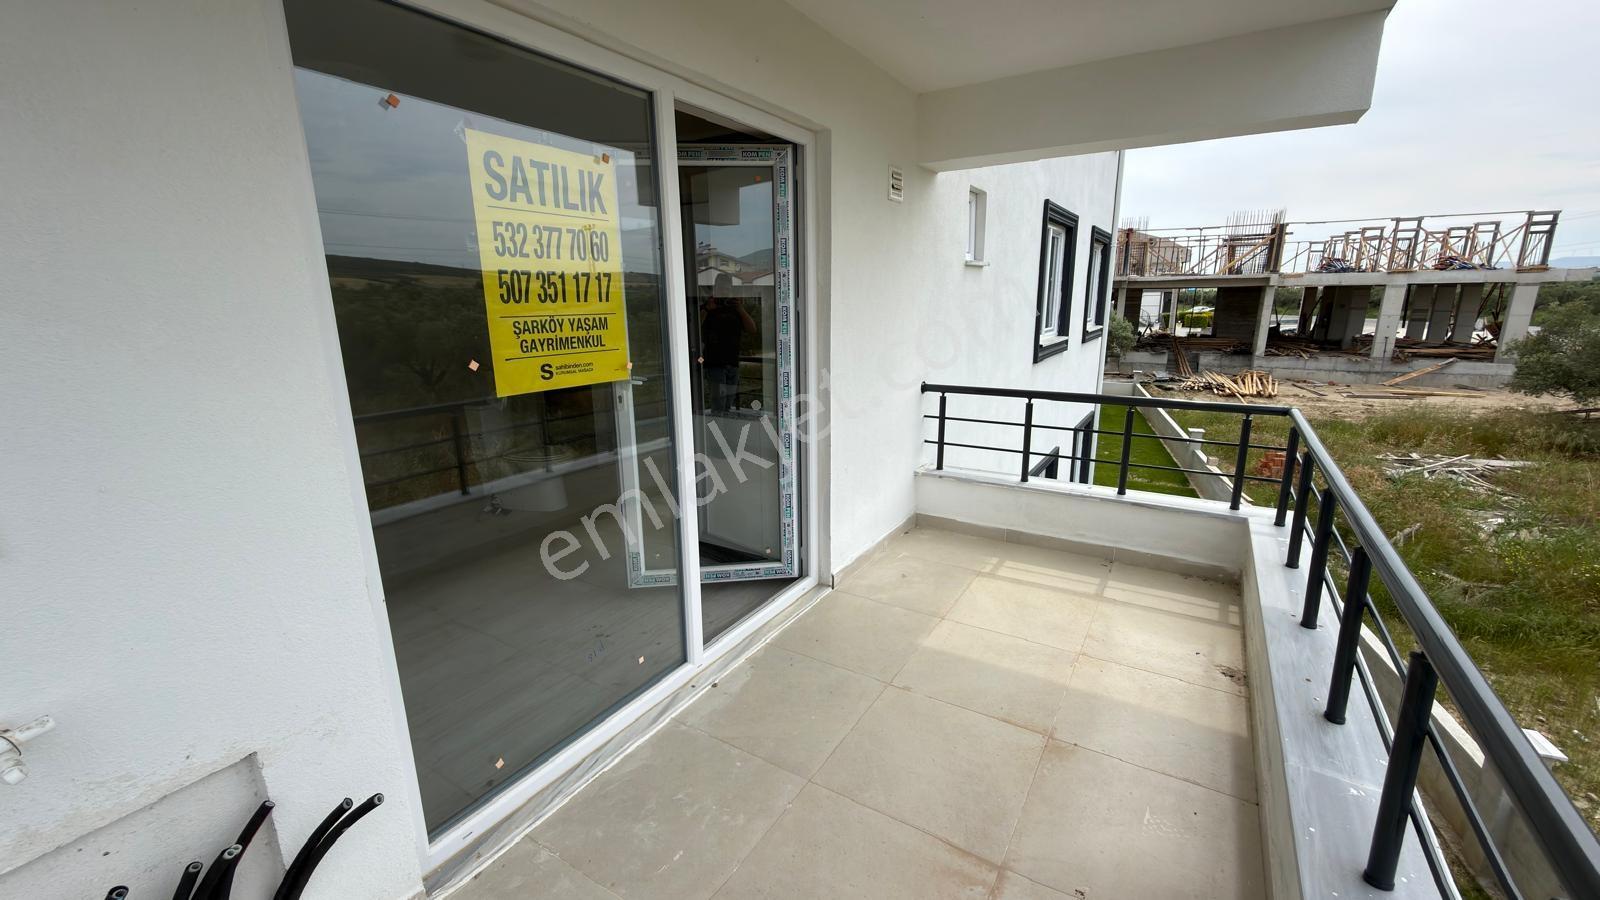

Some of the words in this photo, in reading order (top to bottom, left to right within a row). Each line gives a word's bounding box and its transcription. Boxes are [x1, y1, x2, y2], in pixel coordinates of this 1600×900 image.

[483, 150, 607, 215] SATILIK
[492, 221, 529, 258] 532
[532, 224, 562, 260] 377
[566, 228, 587, 261] 70
[589, 230, 609, 262] 60
[498, 269, 531, 304] 507
[536, 270, 567, 303] 351
[573, 271, 590, 303] 17
[595, 271, 611, 303] 17
[513, 315, 564, 339] ŞARKÖY
[568, 317, 608, 334] YAŞAM
[520, 334, 606, 353] GAYRİMENKUL
[540, 363, 554, 380] S
[555, 362, 594, 371] sahibinden.com
